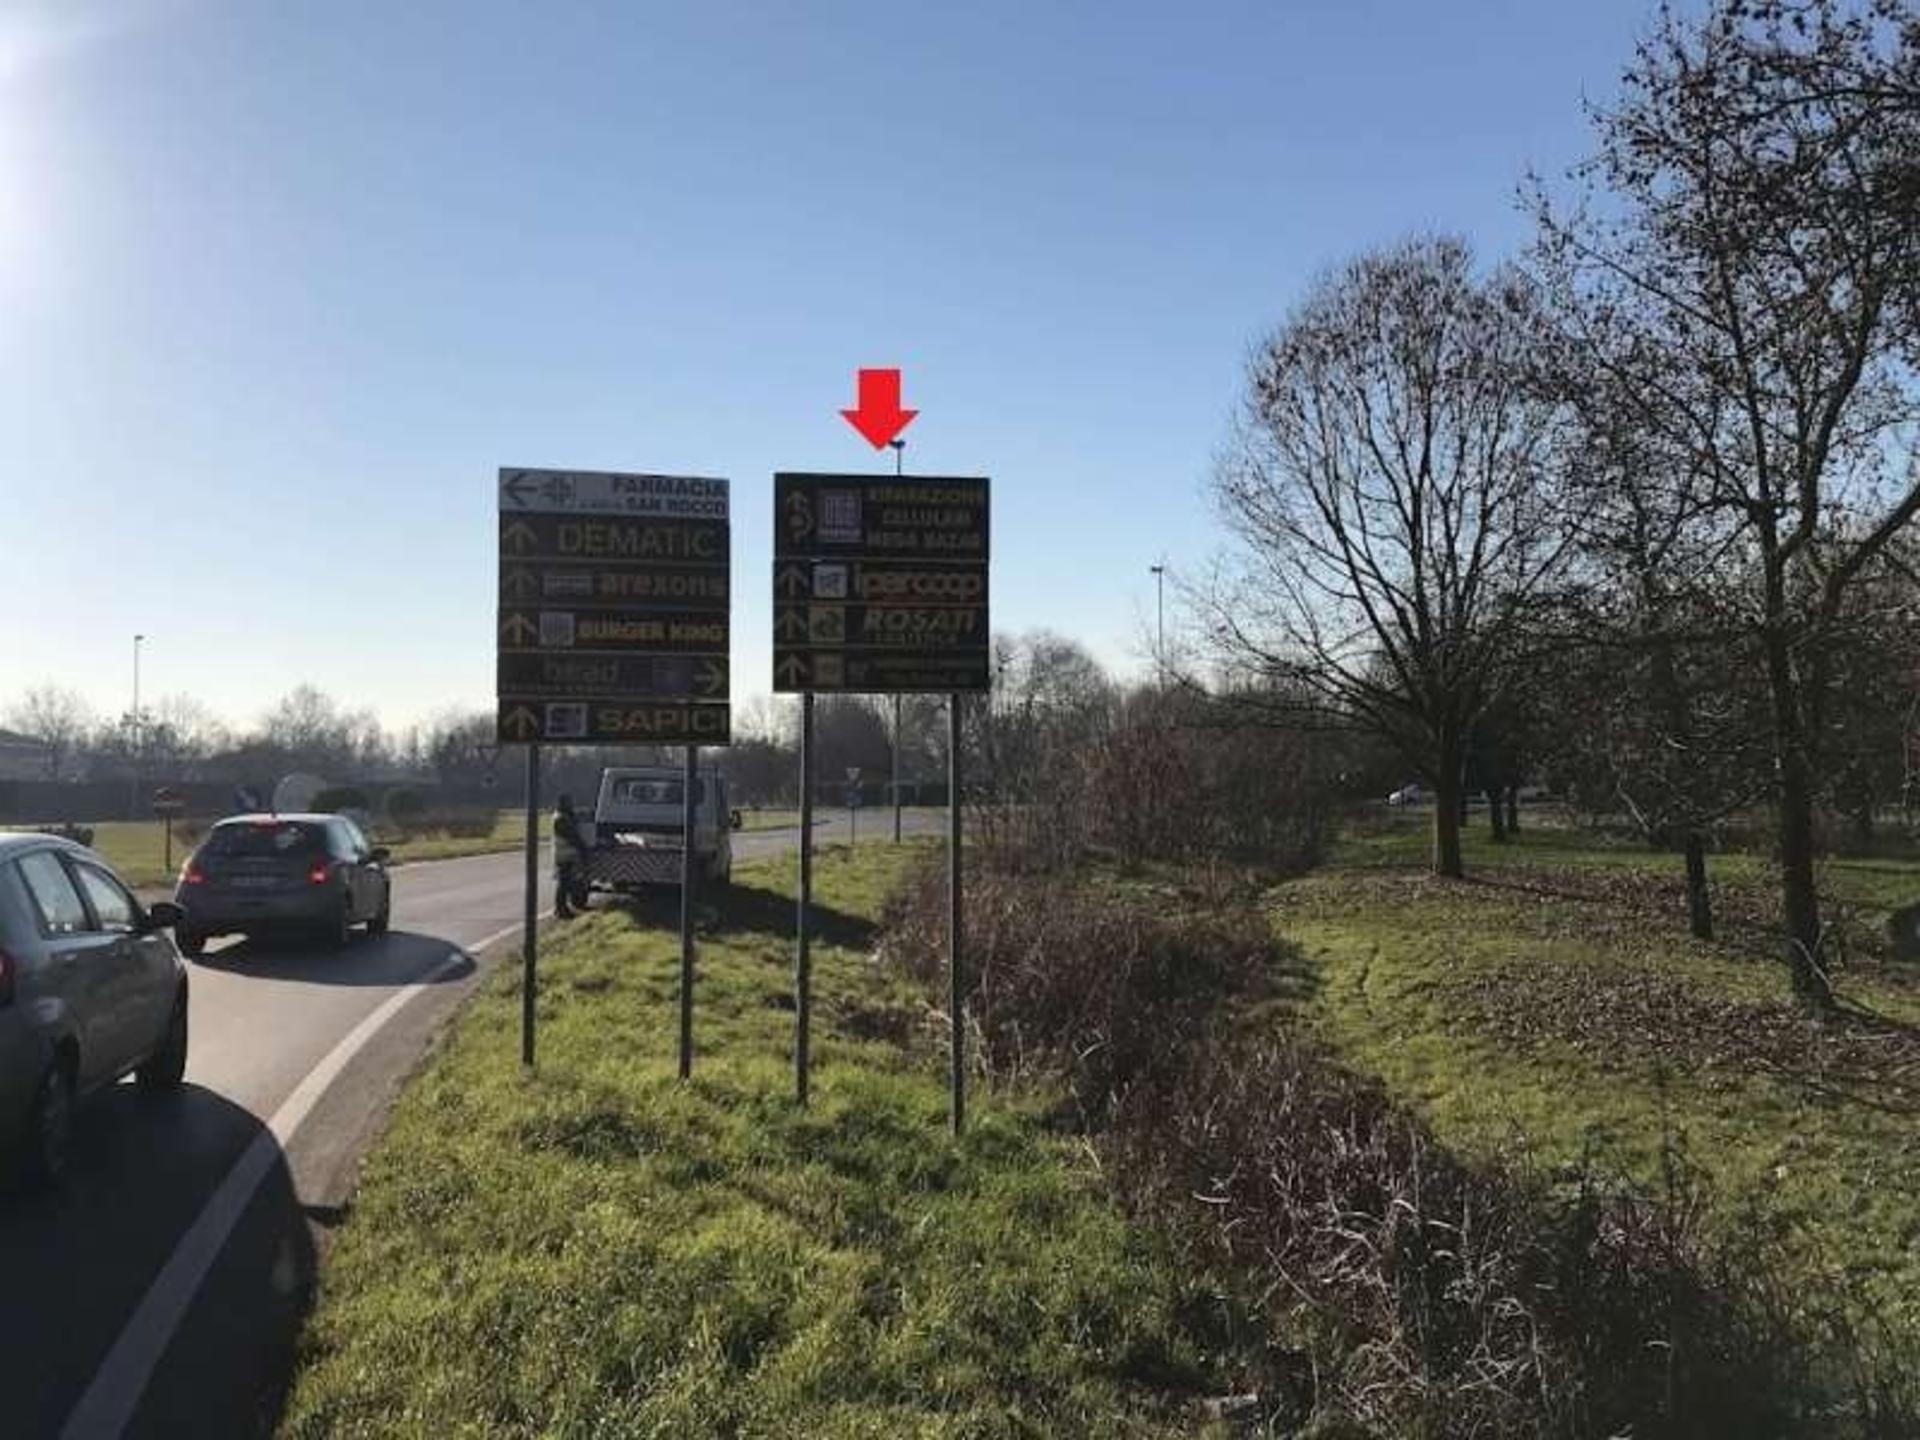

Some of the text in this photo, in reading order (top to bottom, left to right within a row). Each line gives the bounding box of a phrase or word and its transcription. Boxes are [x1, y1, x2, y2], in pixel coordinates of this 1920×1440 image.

[626, 498, 661, 512] SAN
[558, 523, 715, 556] DEMATIC
[577, 620, 724, 642] BURGER KING
